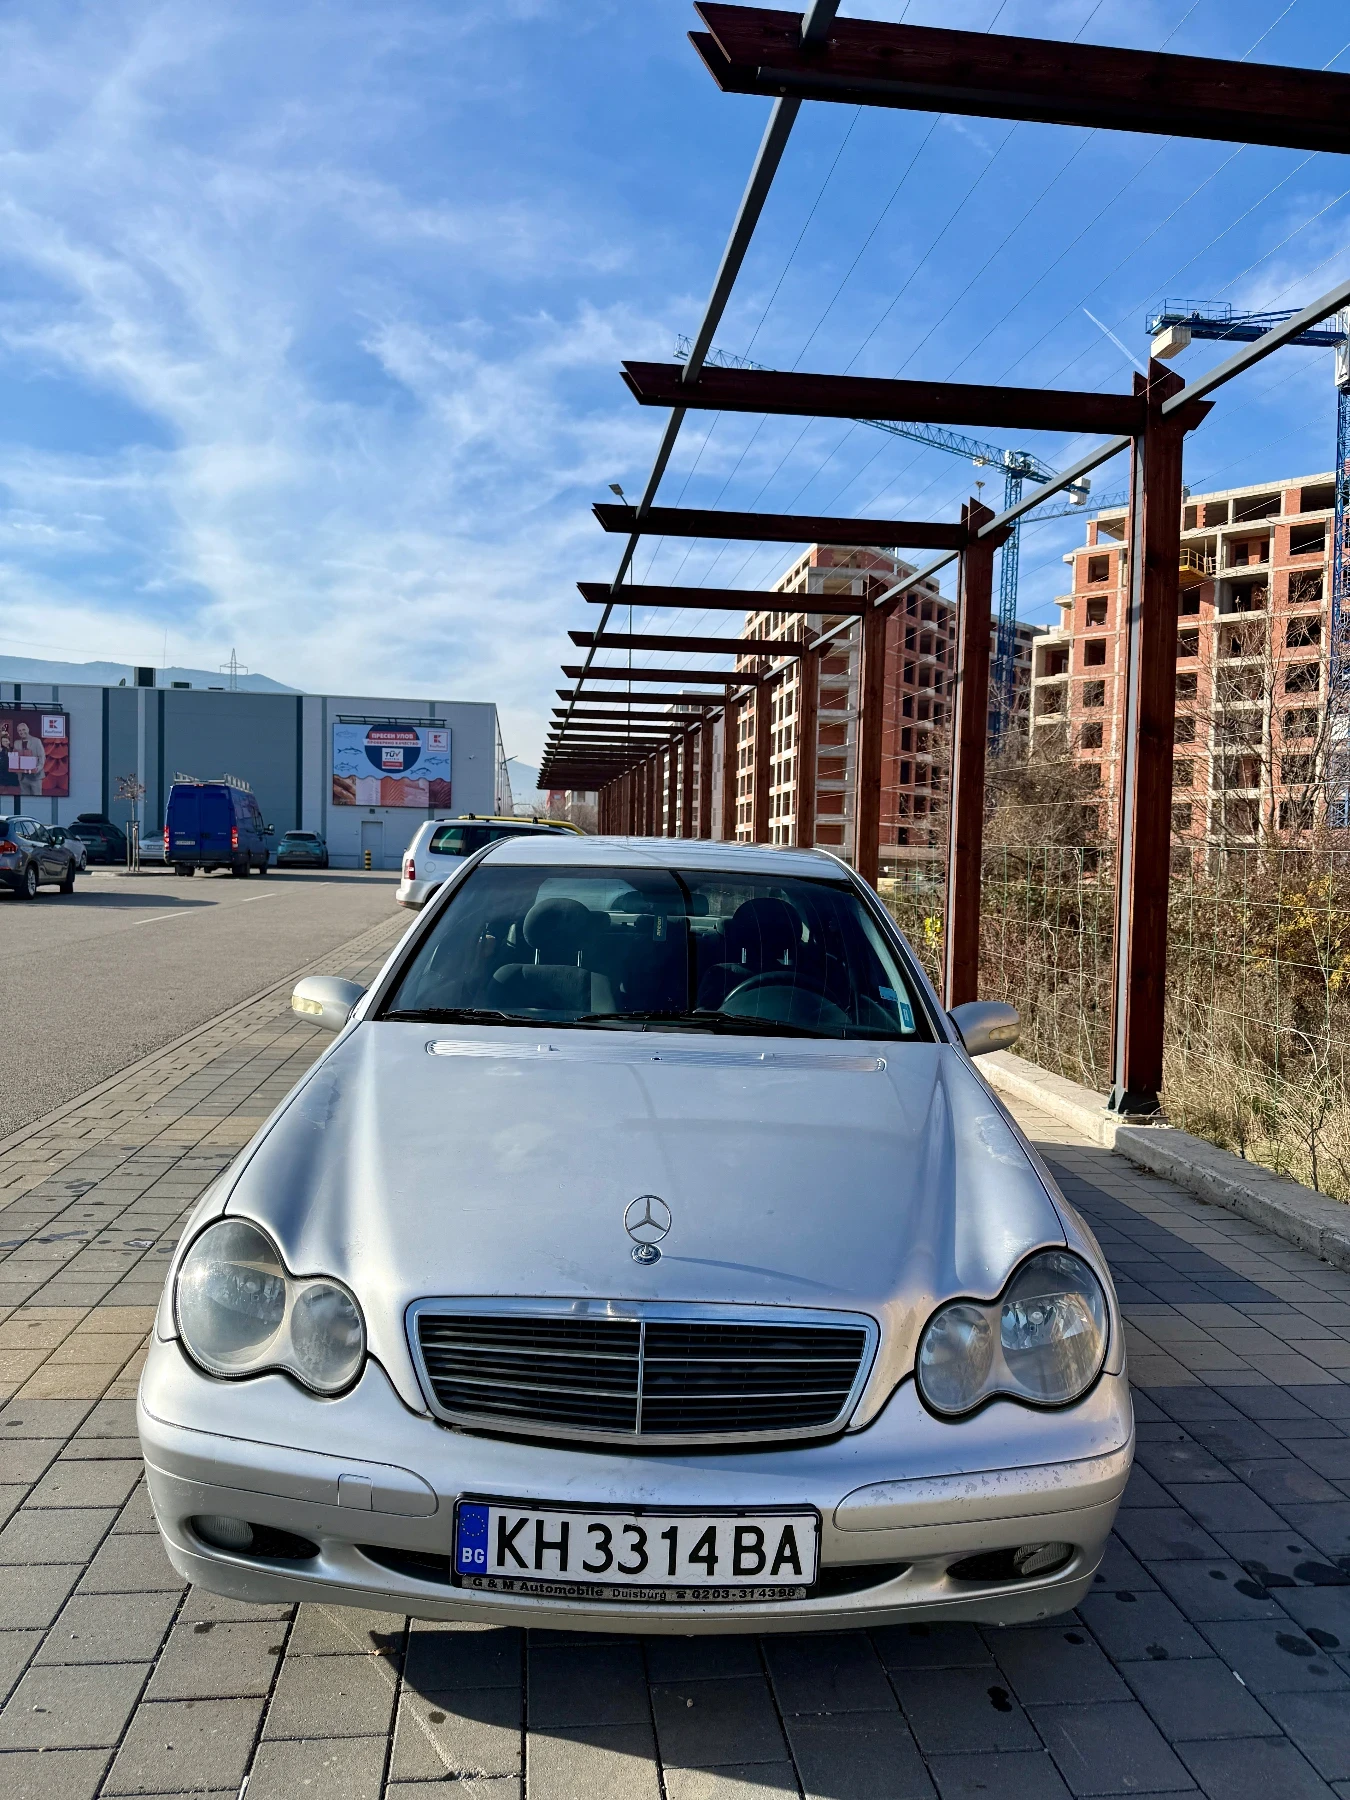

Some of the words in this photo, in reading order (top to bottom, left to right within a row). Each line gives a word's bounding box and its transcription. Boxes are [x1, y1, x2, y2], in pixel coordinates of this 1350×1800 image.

[384, 750, 401, 758] TÜV
[462, 1547, 485, 1564] BG
[472, 1577, 483, 1588] G
[487, 1579, 498, 1589] &
[502, 1580, 515, 1591] M
[519, 1581, 604, 1598] Automobile
[612, 1588, 667, 1601] Duisburg
